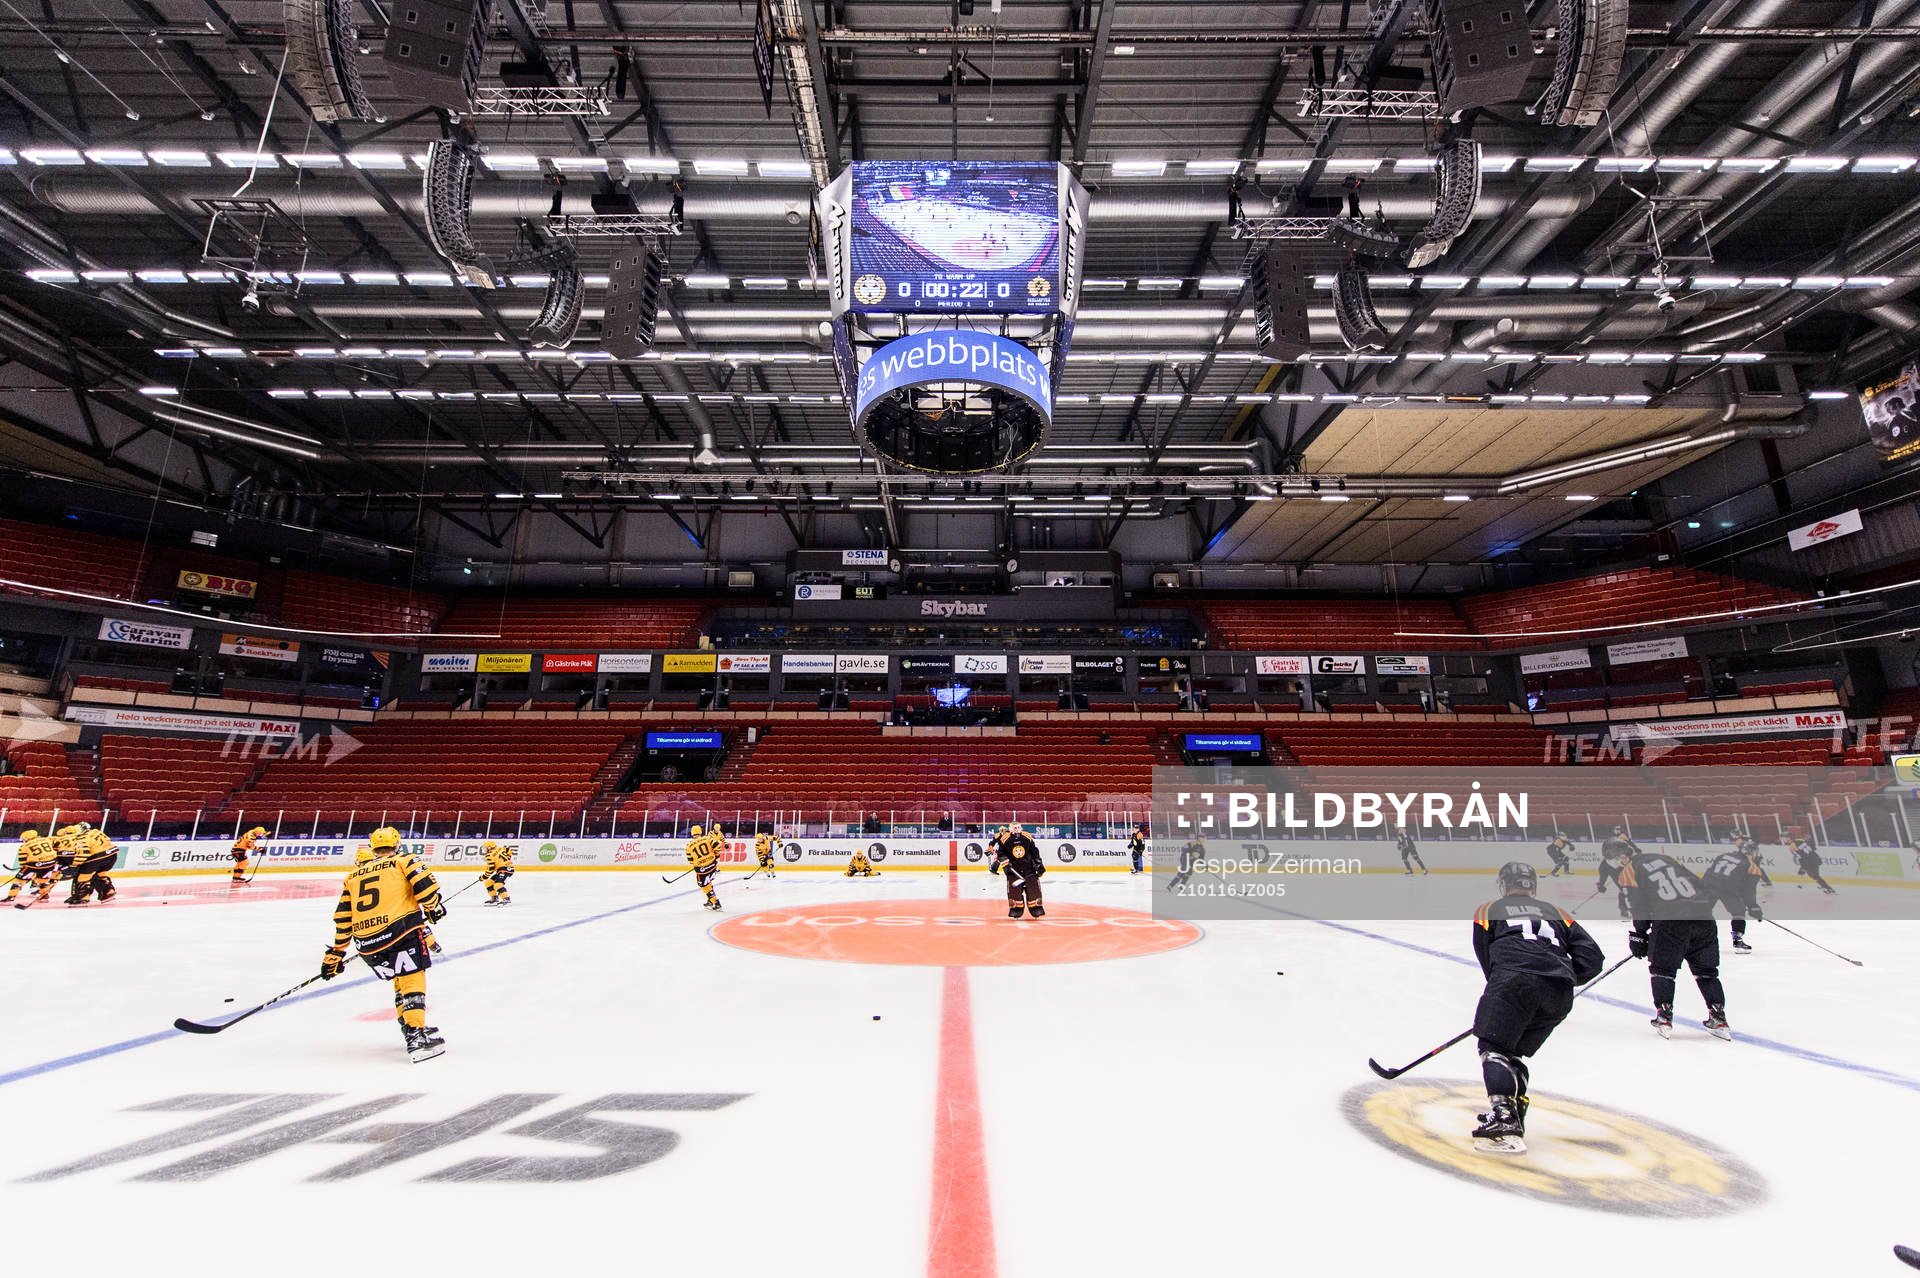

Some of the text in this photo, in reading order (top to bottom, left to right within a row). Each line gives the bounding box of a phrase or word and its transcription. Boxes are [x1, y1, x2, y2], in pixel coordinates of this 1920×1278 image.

[898, 282, 911, 297] 0
[925, 282, 984, 297] 00:22
[997, 282, 1010, 298] 0
[882, 336, 1036, 386] webbplats
[855, 550, 884, 559] STENA
[206, 575, 252, 595] BIG
[921, 600, 988, 618] Skybar
[119, 624, 182, 640] Caravan
[128, 633, 181, 647] Marine
[554, 659, 579, 667] Gästrike
[783, 660, 833, 668] Handelsbanken
[839, 657, 885, 670] gavle.se
[979, 661, 998, 670] SSG
[116, 713, 140, 721] Hela
[143, 714, 182, 722] veckans
[233, 720, 256, 728] klick!
[1672, 723, 1710, 731] veckans
[1732, 721, 1746, 729] på
[1763, 717, 1788, 726] klick!
[1832, 715, 1920, 753] ITE
[219, 729, 321, 761] ITEM
[1543, 733, 1632, 763] ITEM
[617, 843, 641, 852] ABC
[693, 843, 710, 859] 10
[171, 850, 236, 863] Bilmetro
[1648, 866, 1697, 900] 36
[356, 876, 380, 912] 5
